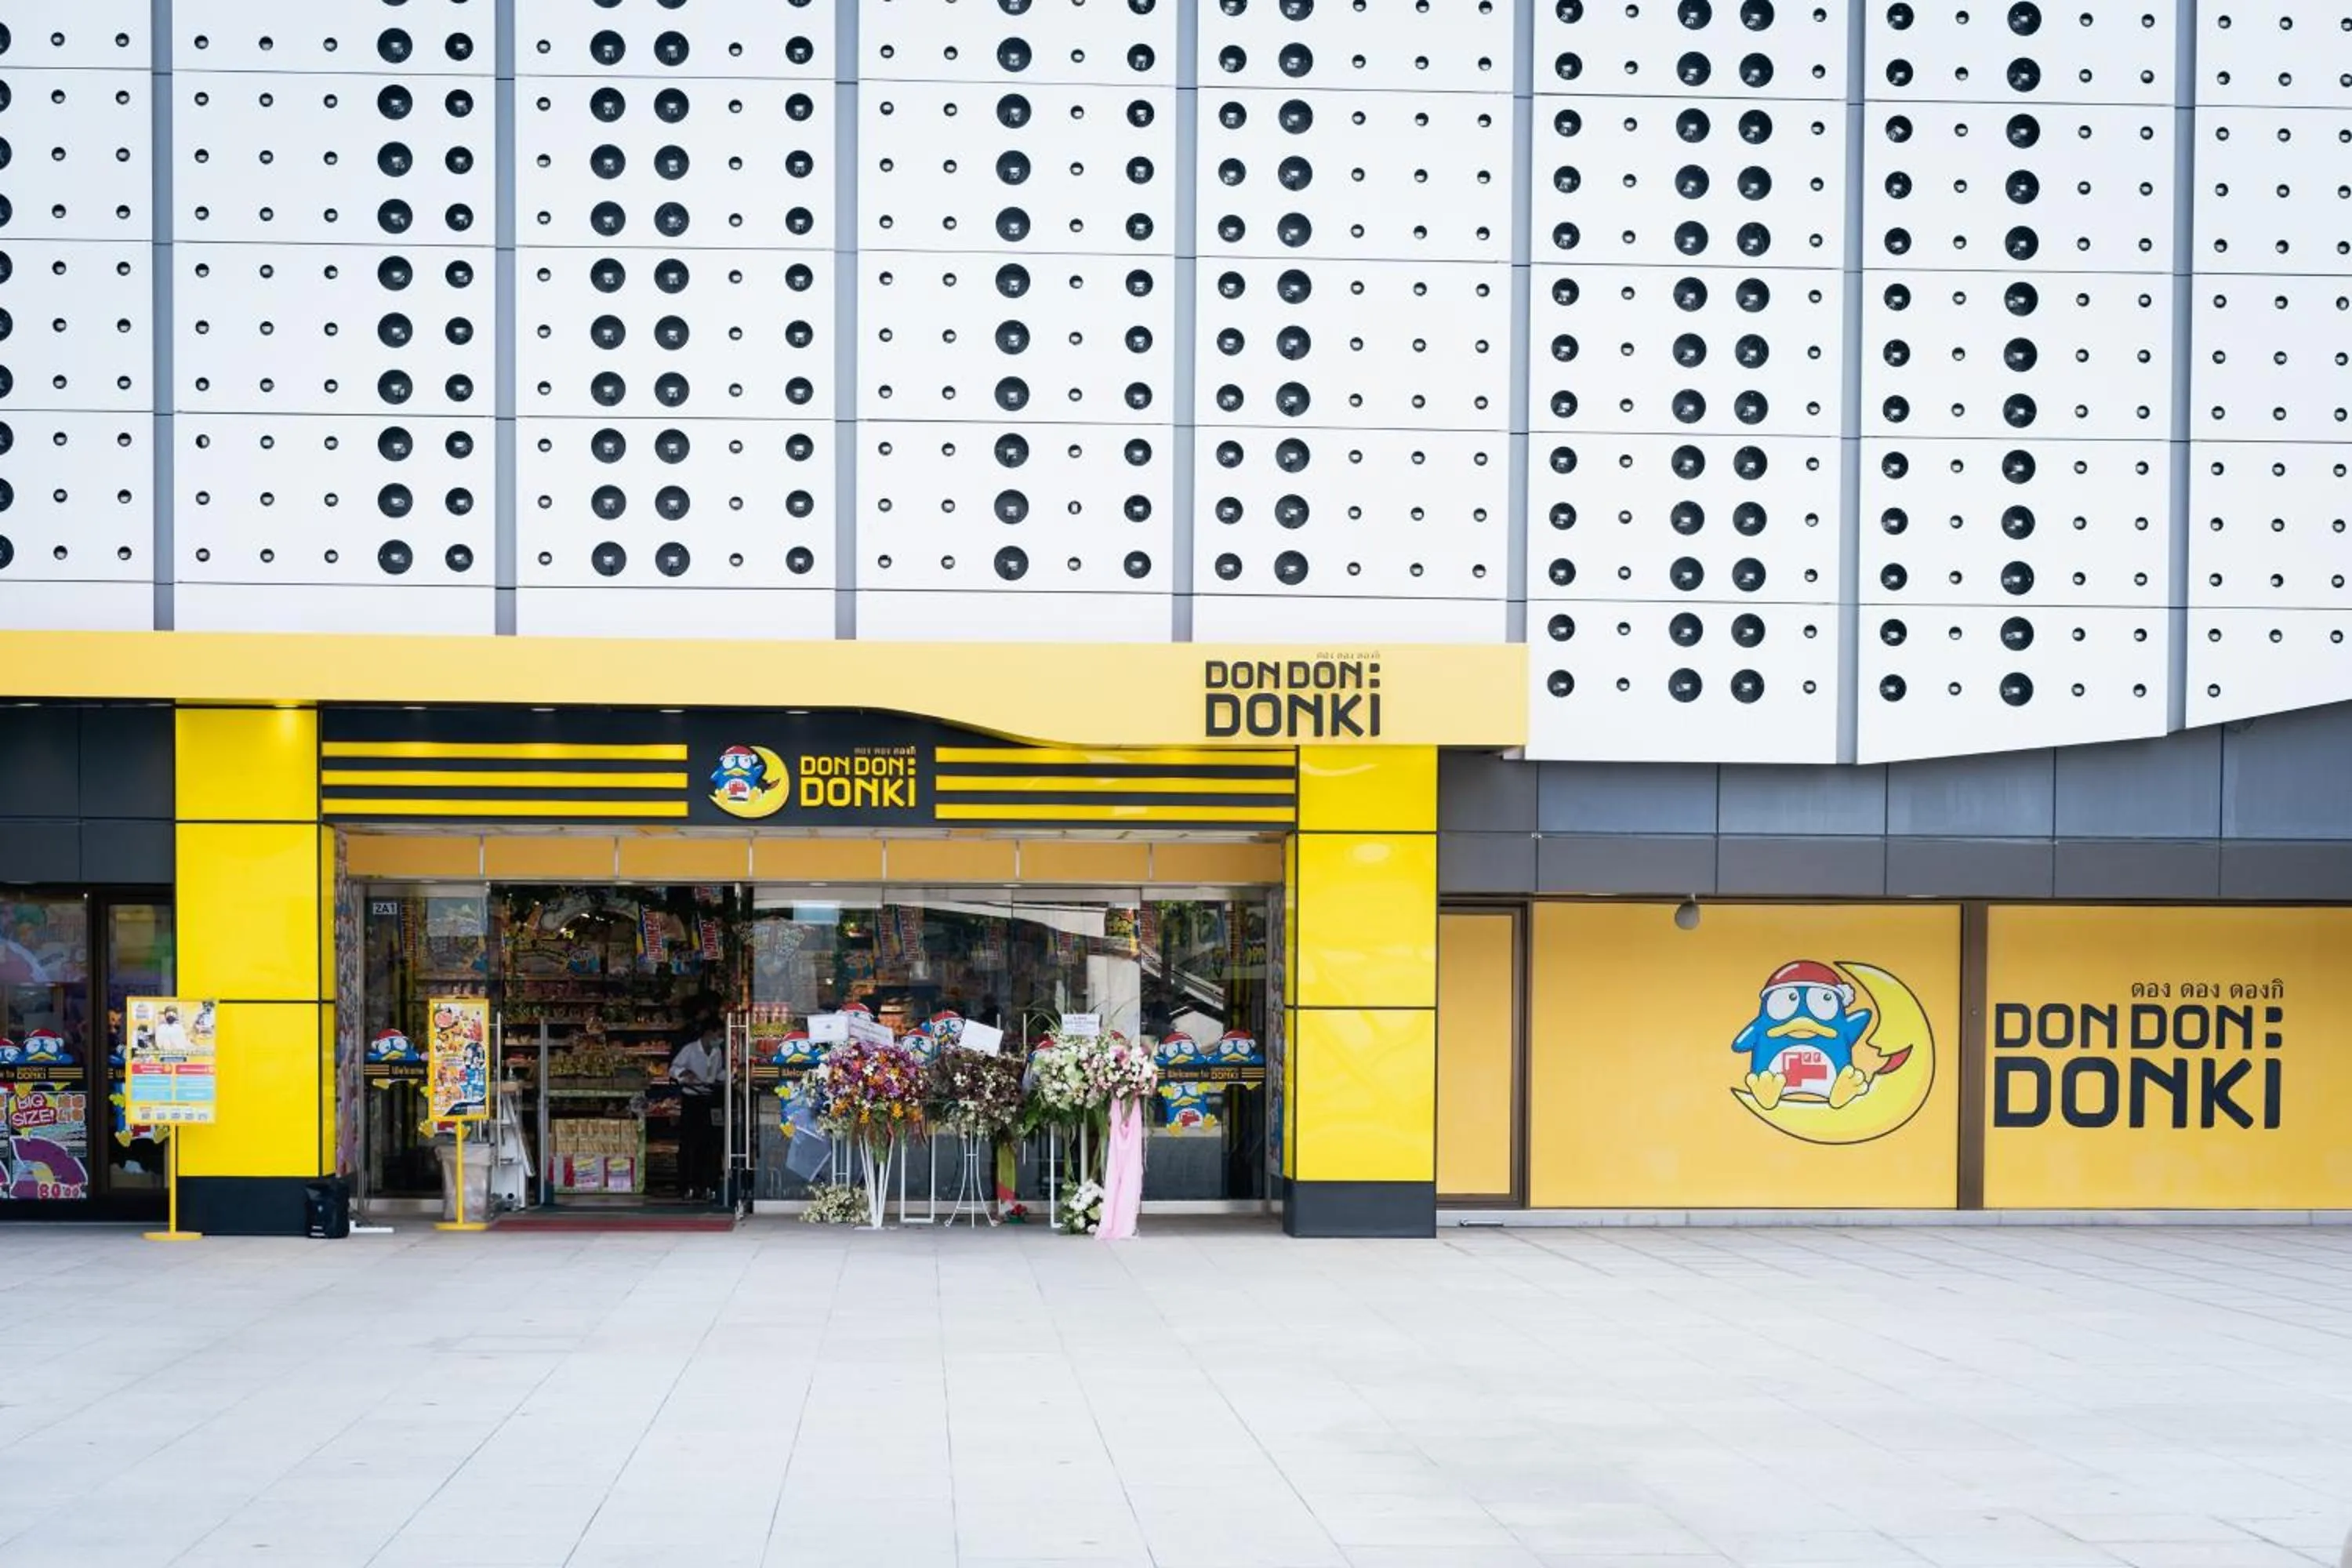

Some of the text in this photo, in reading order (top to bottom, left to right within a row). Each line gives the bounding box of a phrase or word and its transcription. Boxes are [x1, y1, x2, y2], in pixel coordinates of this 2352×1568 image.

[1206, 661, 1280, 689] DON
[800, 757, 850, 775] DON
[2131, 982, 2171, 998] ดอง
[2180, 982, 2220, 999] ดอง
[1995, 1004, 2117, 1048] DON
[17, 1094, 44, 1109] BIG
